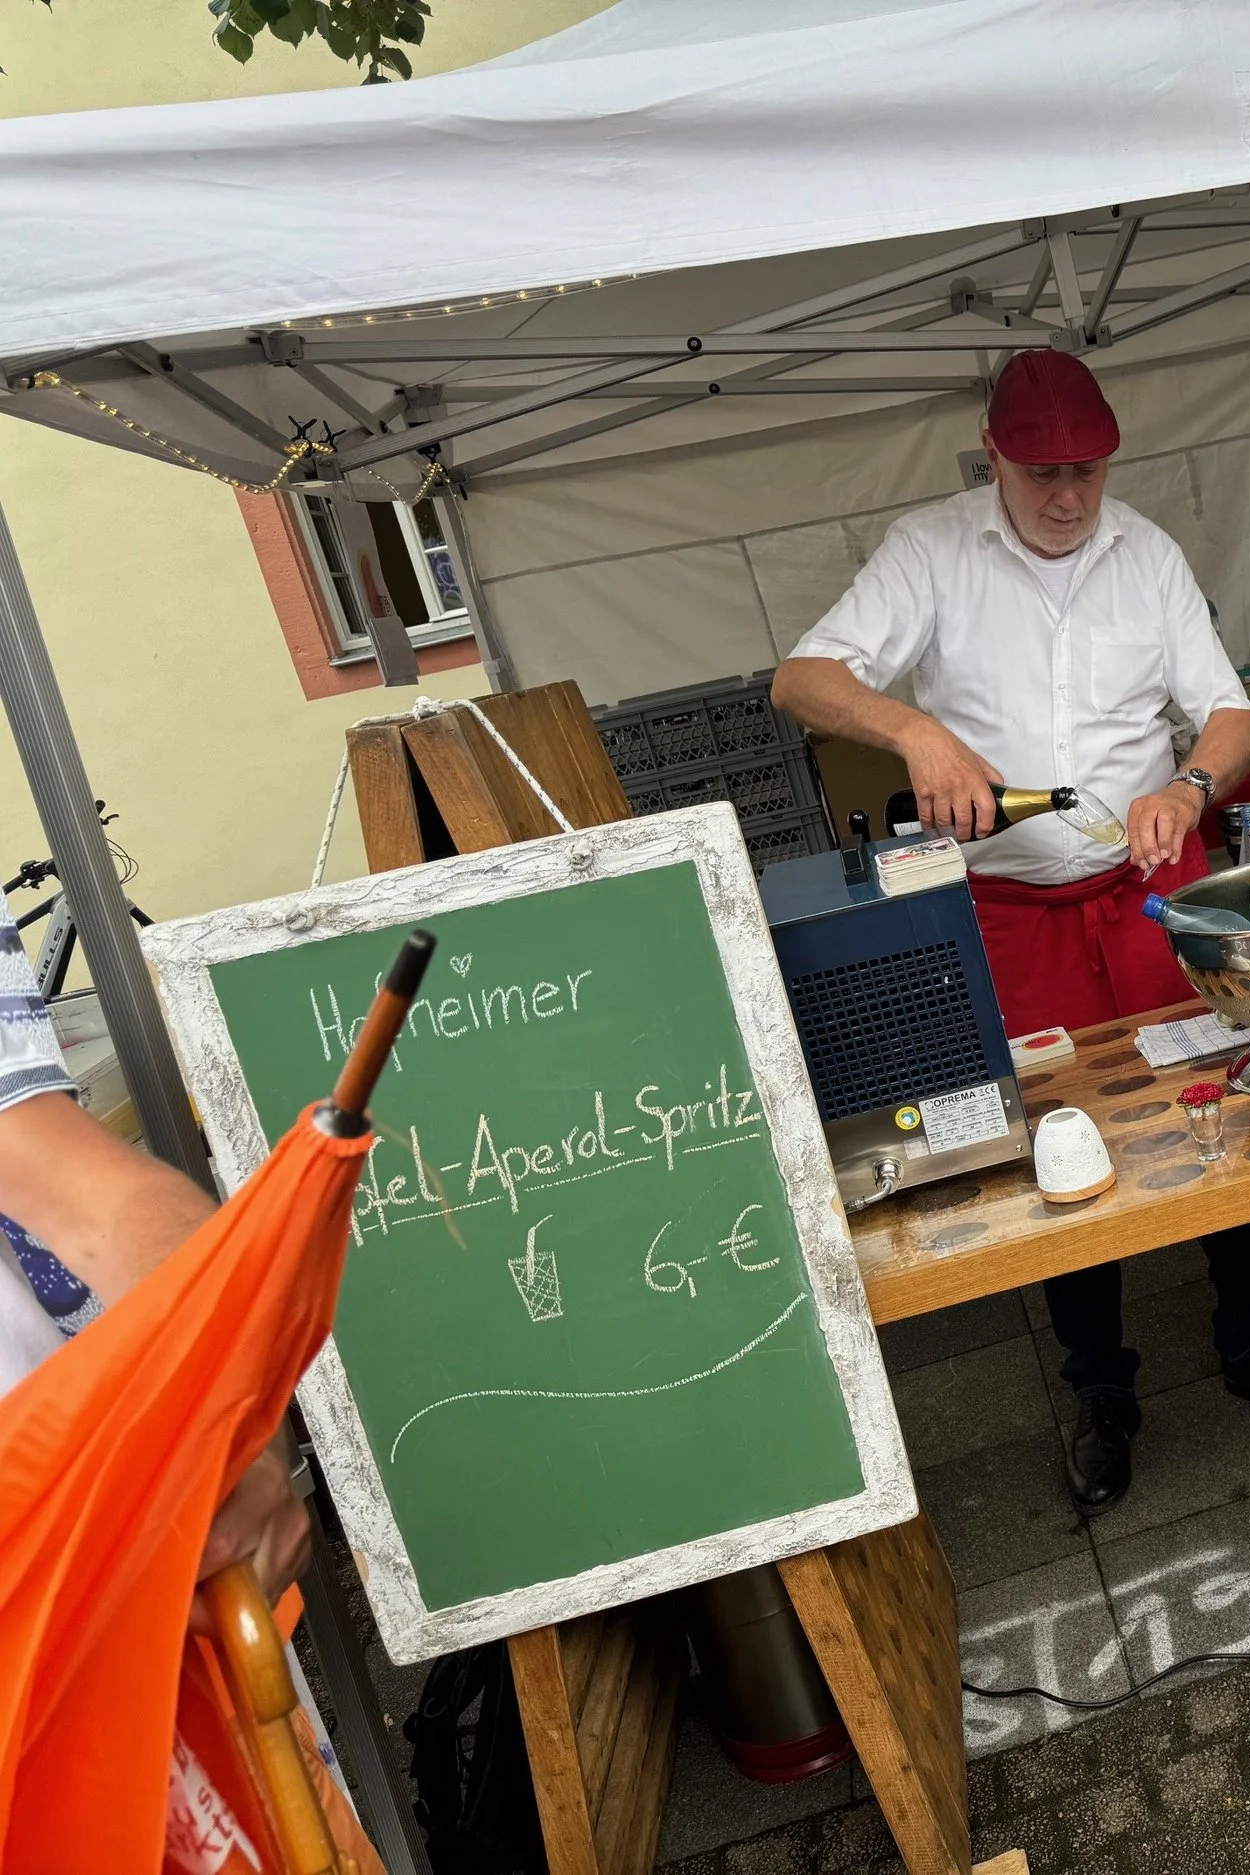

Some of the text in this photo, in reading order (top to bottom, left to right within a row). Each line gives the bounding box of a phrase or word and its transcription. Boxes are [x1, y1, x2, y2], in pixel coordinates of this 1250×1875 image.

[976, 462, 992, 473] lov
[974, 472, 987, 481] my
[933, 1090, 976, 1107] OPREMA
[350, 1063, 764, 1248] pfel-Aperol-Spritz
[717, 1204, 781, 1272] €
